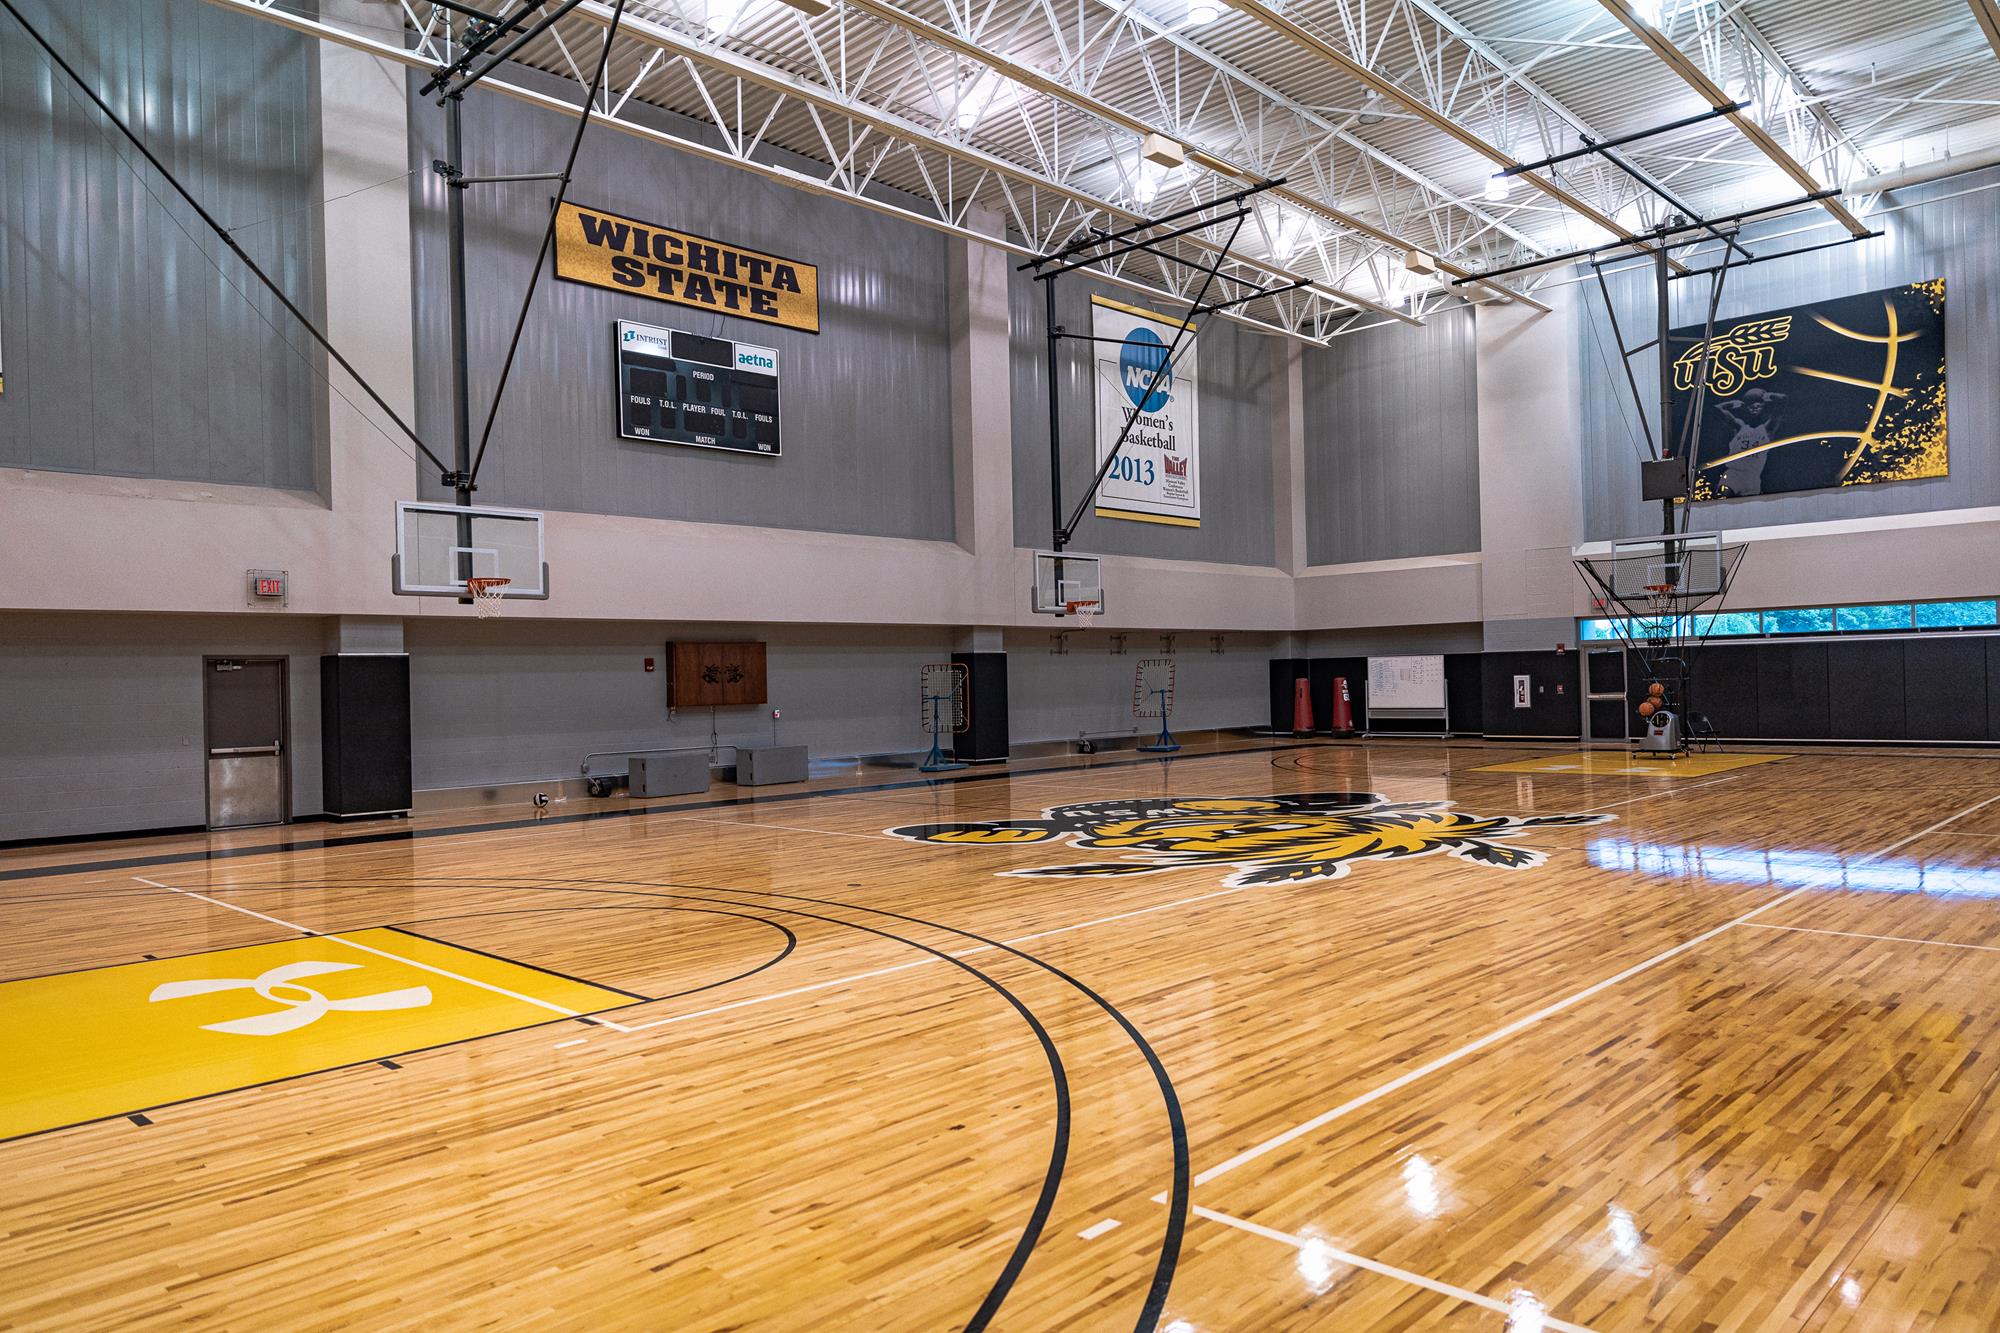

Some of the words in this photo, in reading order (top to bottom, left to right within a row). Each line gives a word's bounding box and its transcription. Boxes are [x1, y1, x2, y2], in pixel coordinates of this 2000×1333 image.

[578, 212, 801, 293] WICHITA
[611, 255, 779, 318] STATE
[636, 333, 667, 346] INTRUST
[738, 352, 773, 369] aetna
[692, 370, 715, 381] PERIOD
[630, 395, 651, 406] FOULS
[659, 399, 677, 409] T.O.L.
[682, 403, 706, 414] PLAYER
[710, 407, 726, 417] FOUL
[732, 410, 749, 420] T.O.L.
[754, 414, 773, 424] FOULS
[1121, 406, 1174, 431] Women's
[634, 427, 650, 436] WON
[695, 435, 716, 445] MATCH
[757, 443, 771, 452] WON
[1108, 454, 1155, 486] 2013
[260, 579, 280, 593] EXIT
